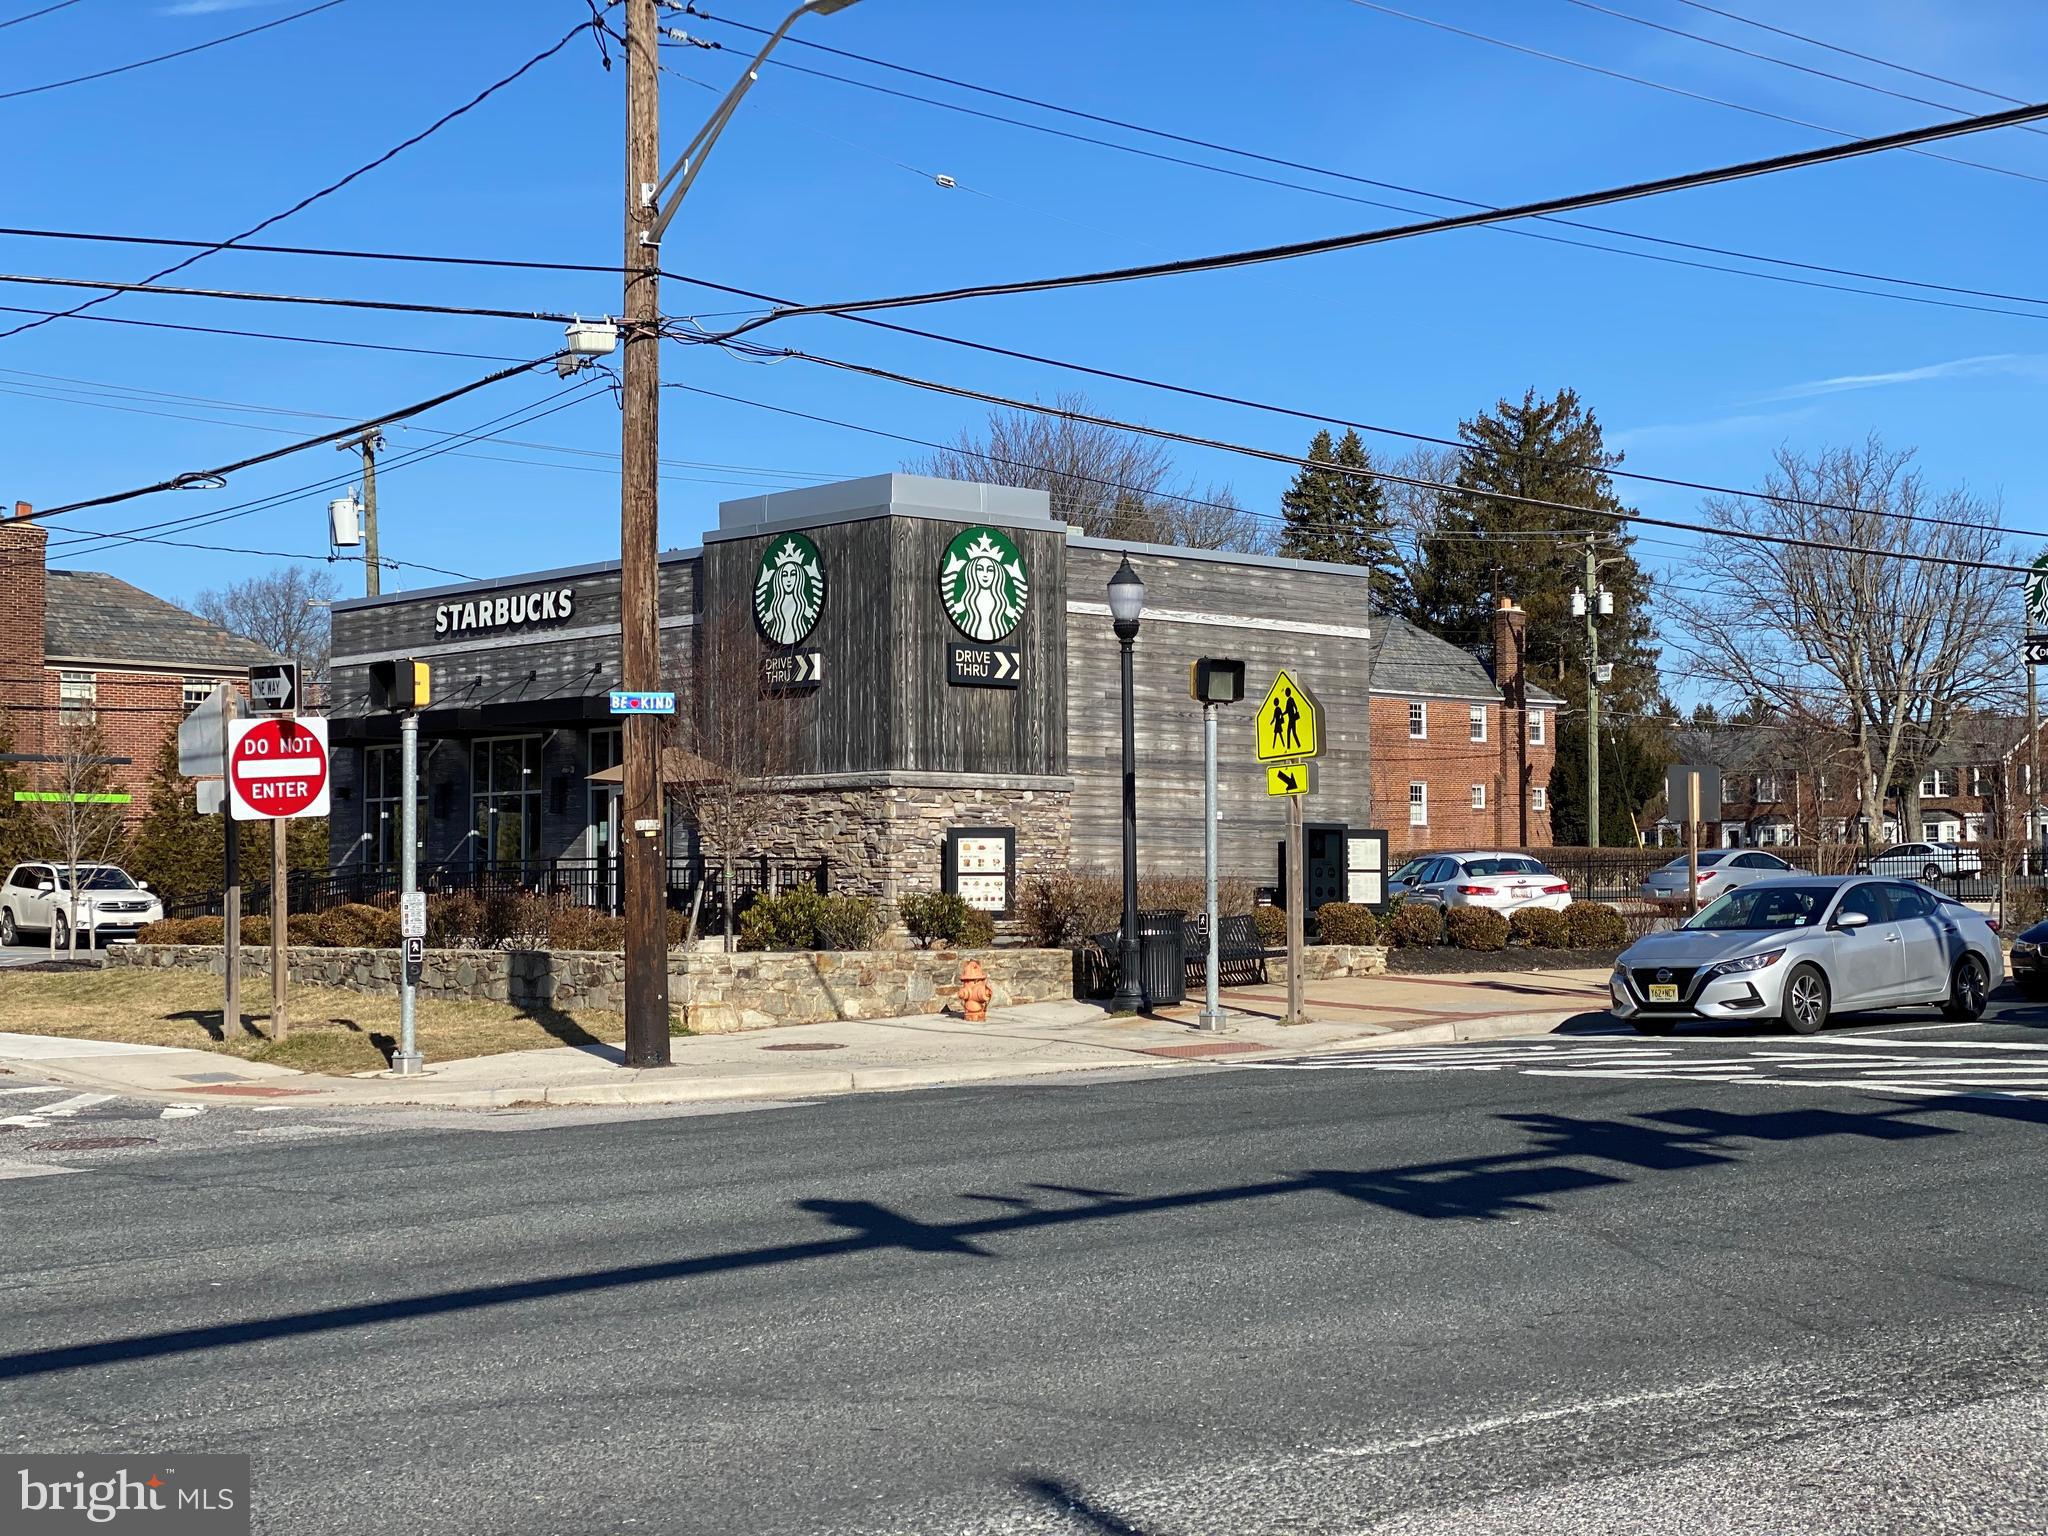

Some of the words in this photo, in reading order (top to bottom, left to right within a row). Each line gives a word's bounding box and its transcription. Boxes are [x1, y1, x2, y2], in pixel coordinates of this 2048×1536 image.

[435, 588, 572, 633] STARBUCKS
[765, 656, 793, 671] DRIVE
[955, 649, 991, 664] DRIVE
[765, 669, 791, 683] THRU
[955, 663, 988, 677] THRU
[253, 681, 266, 696] ONE
[267, 680, 280, 696] WAY
[612, 696, 628, 709] BE
[640, 696, 673, 709] KIND
[244, 738, 269, 755] DO
[280, 737, 313, 754] NOT
[252, 781, 308, 799] ENTER
